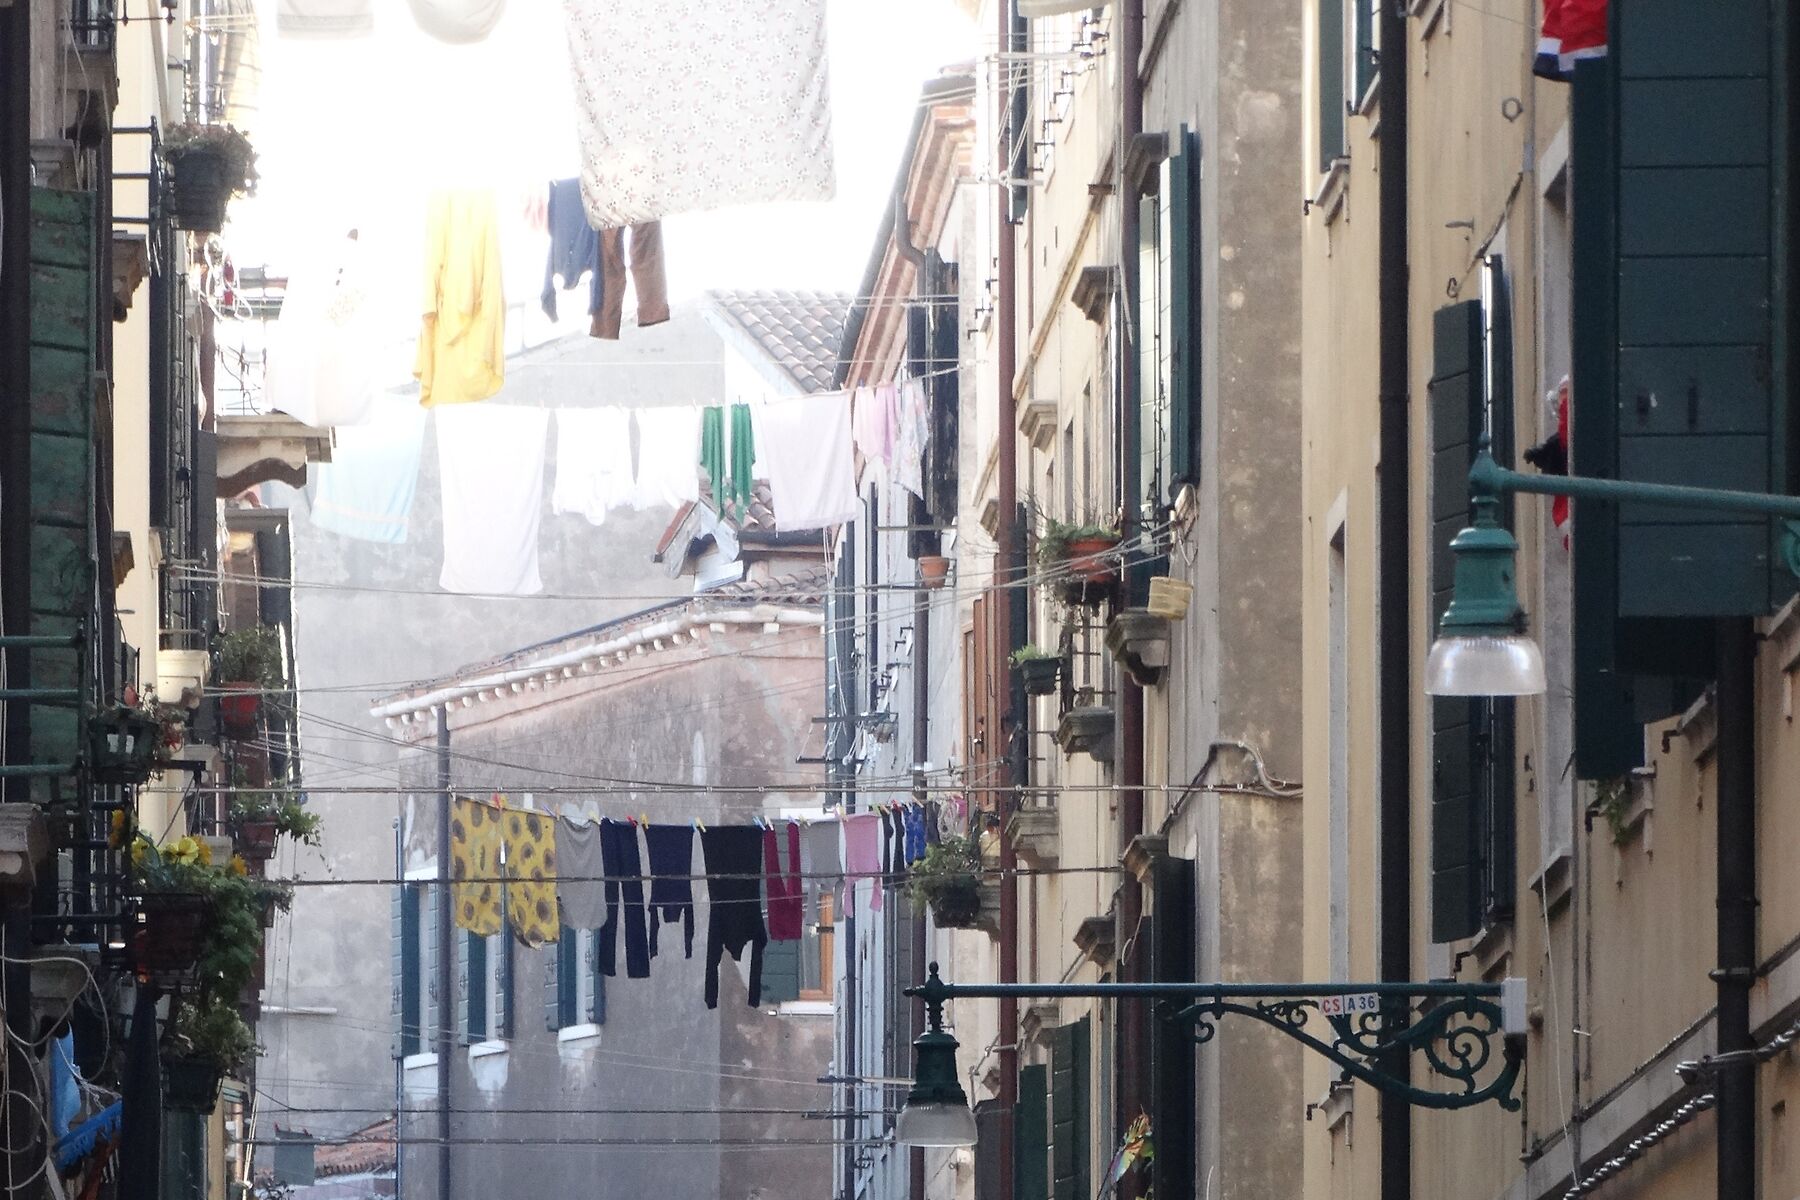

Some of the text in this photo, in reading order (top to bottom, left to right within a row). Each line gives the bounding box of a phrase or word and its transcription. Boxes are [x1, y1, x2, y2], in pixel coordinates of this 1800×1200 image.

[1323, 995, 1375, 1013] CS A 36
